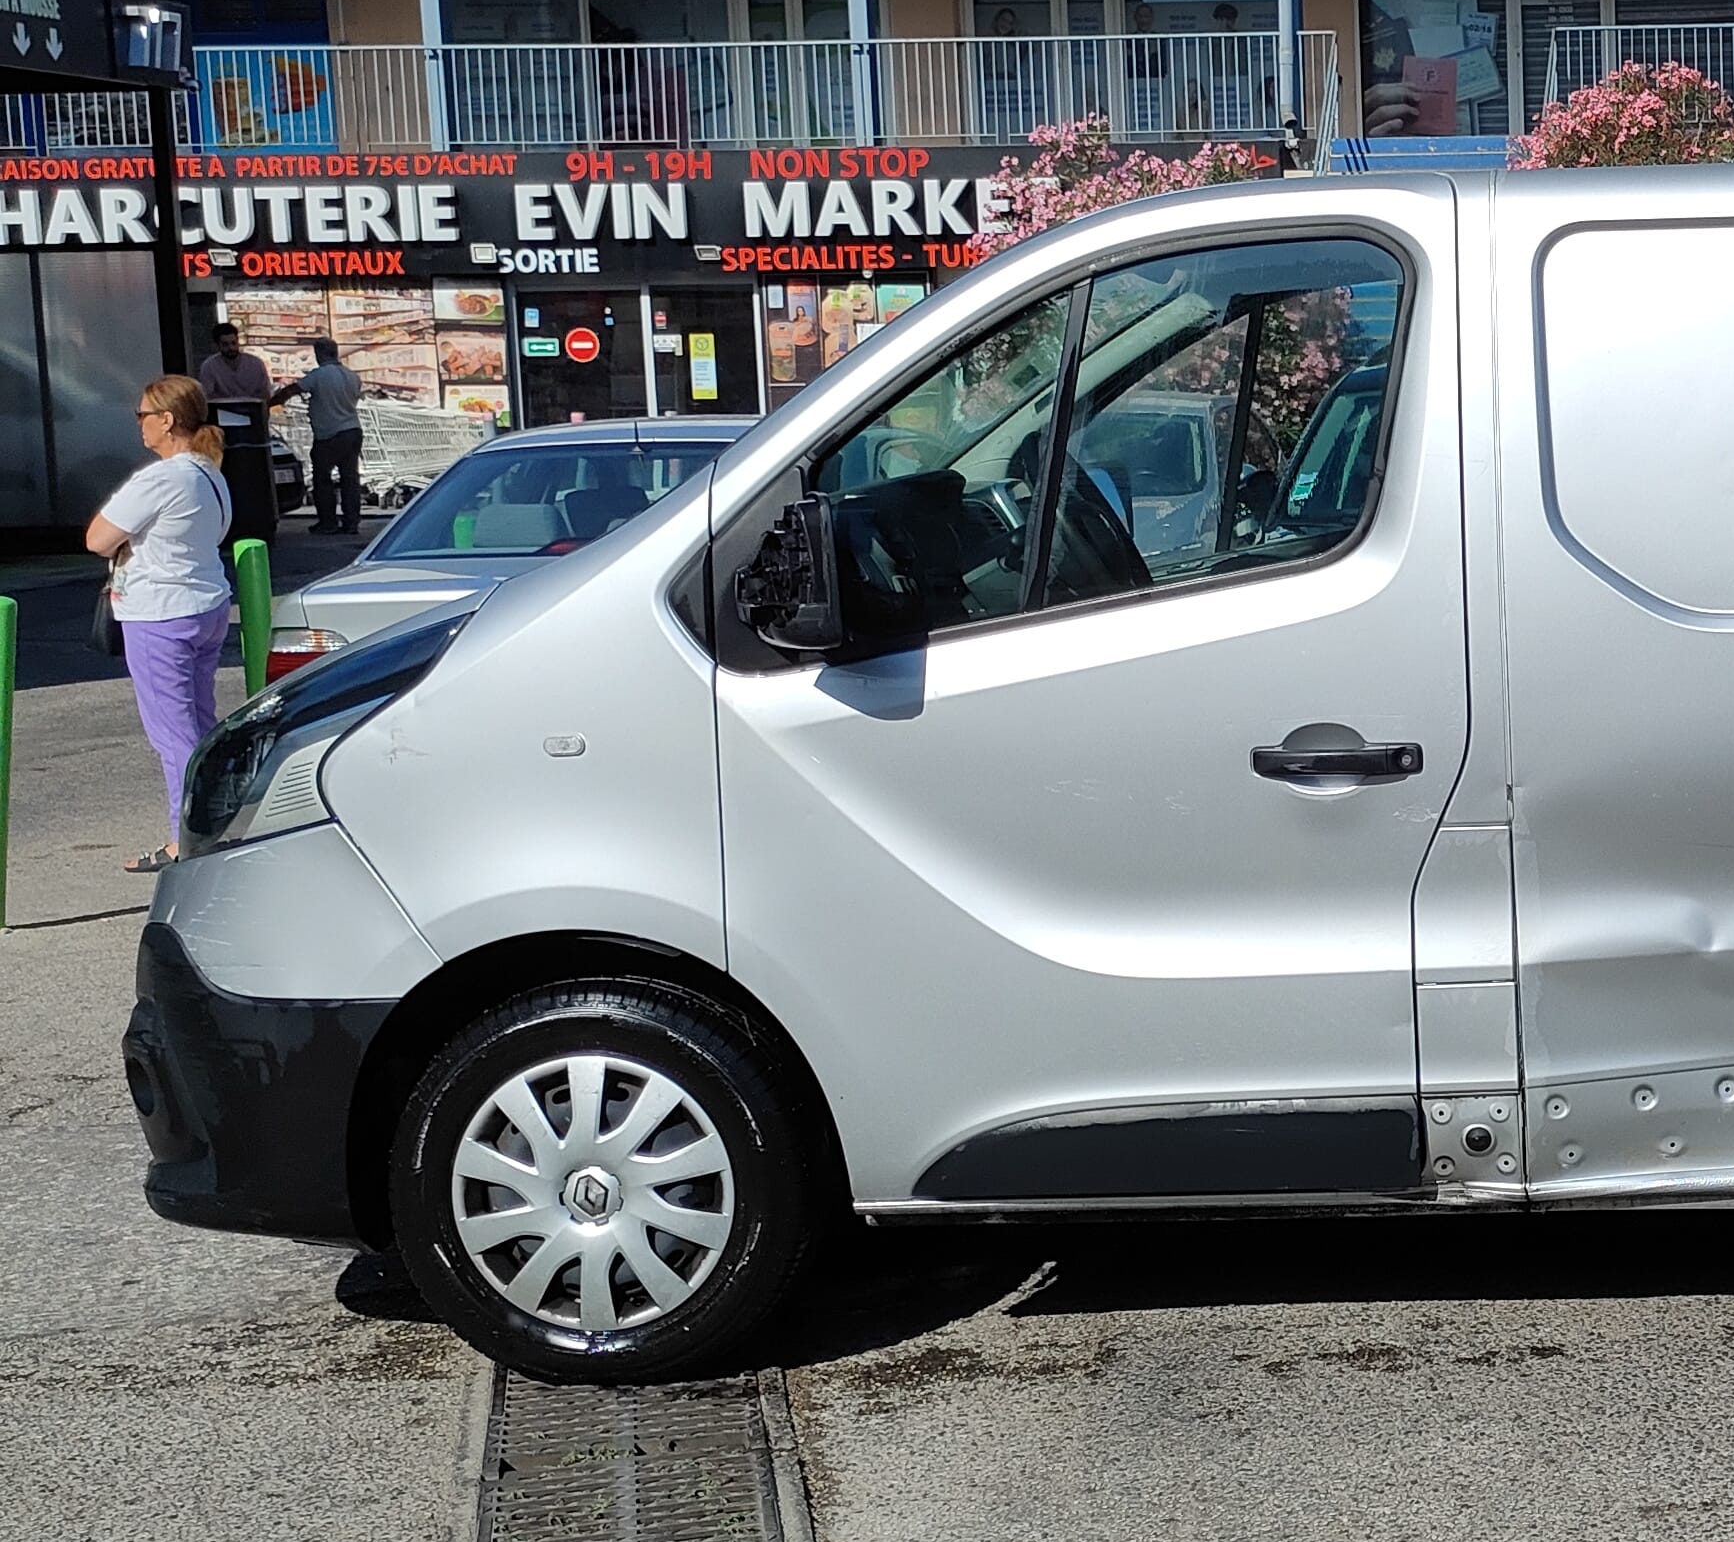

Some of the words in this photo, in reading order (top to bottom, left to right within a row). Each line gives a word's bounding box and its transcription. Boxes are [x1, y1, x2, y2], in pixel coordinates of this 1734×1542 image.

[208, 153, 226, 179] À
[236, 155, 321, 178] PARTIR
[327, 154, 358, 177] DE
[363, 154, 409, 177] 75€
[565, 151, 613, 182] 9H
[645, 150, 712, 181] 19H
[749, 149, 835, 180] NON
[838, 148, 930, 179] STOP
[514, 181, 688, 241] EVIN
[742, 177, 1060, 239] MARKE
[241, 251, 405, 277] ORIENTAUX
[499, 247, 601, 274] SORTIE
[721, 245, 899, 273] SPECIALITES
